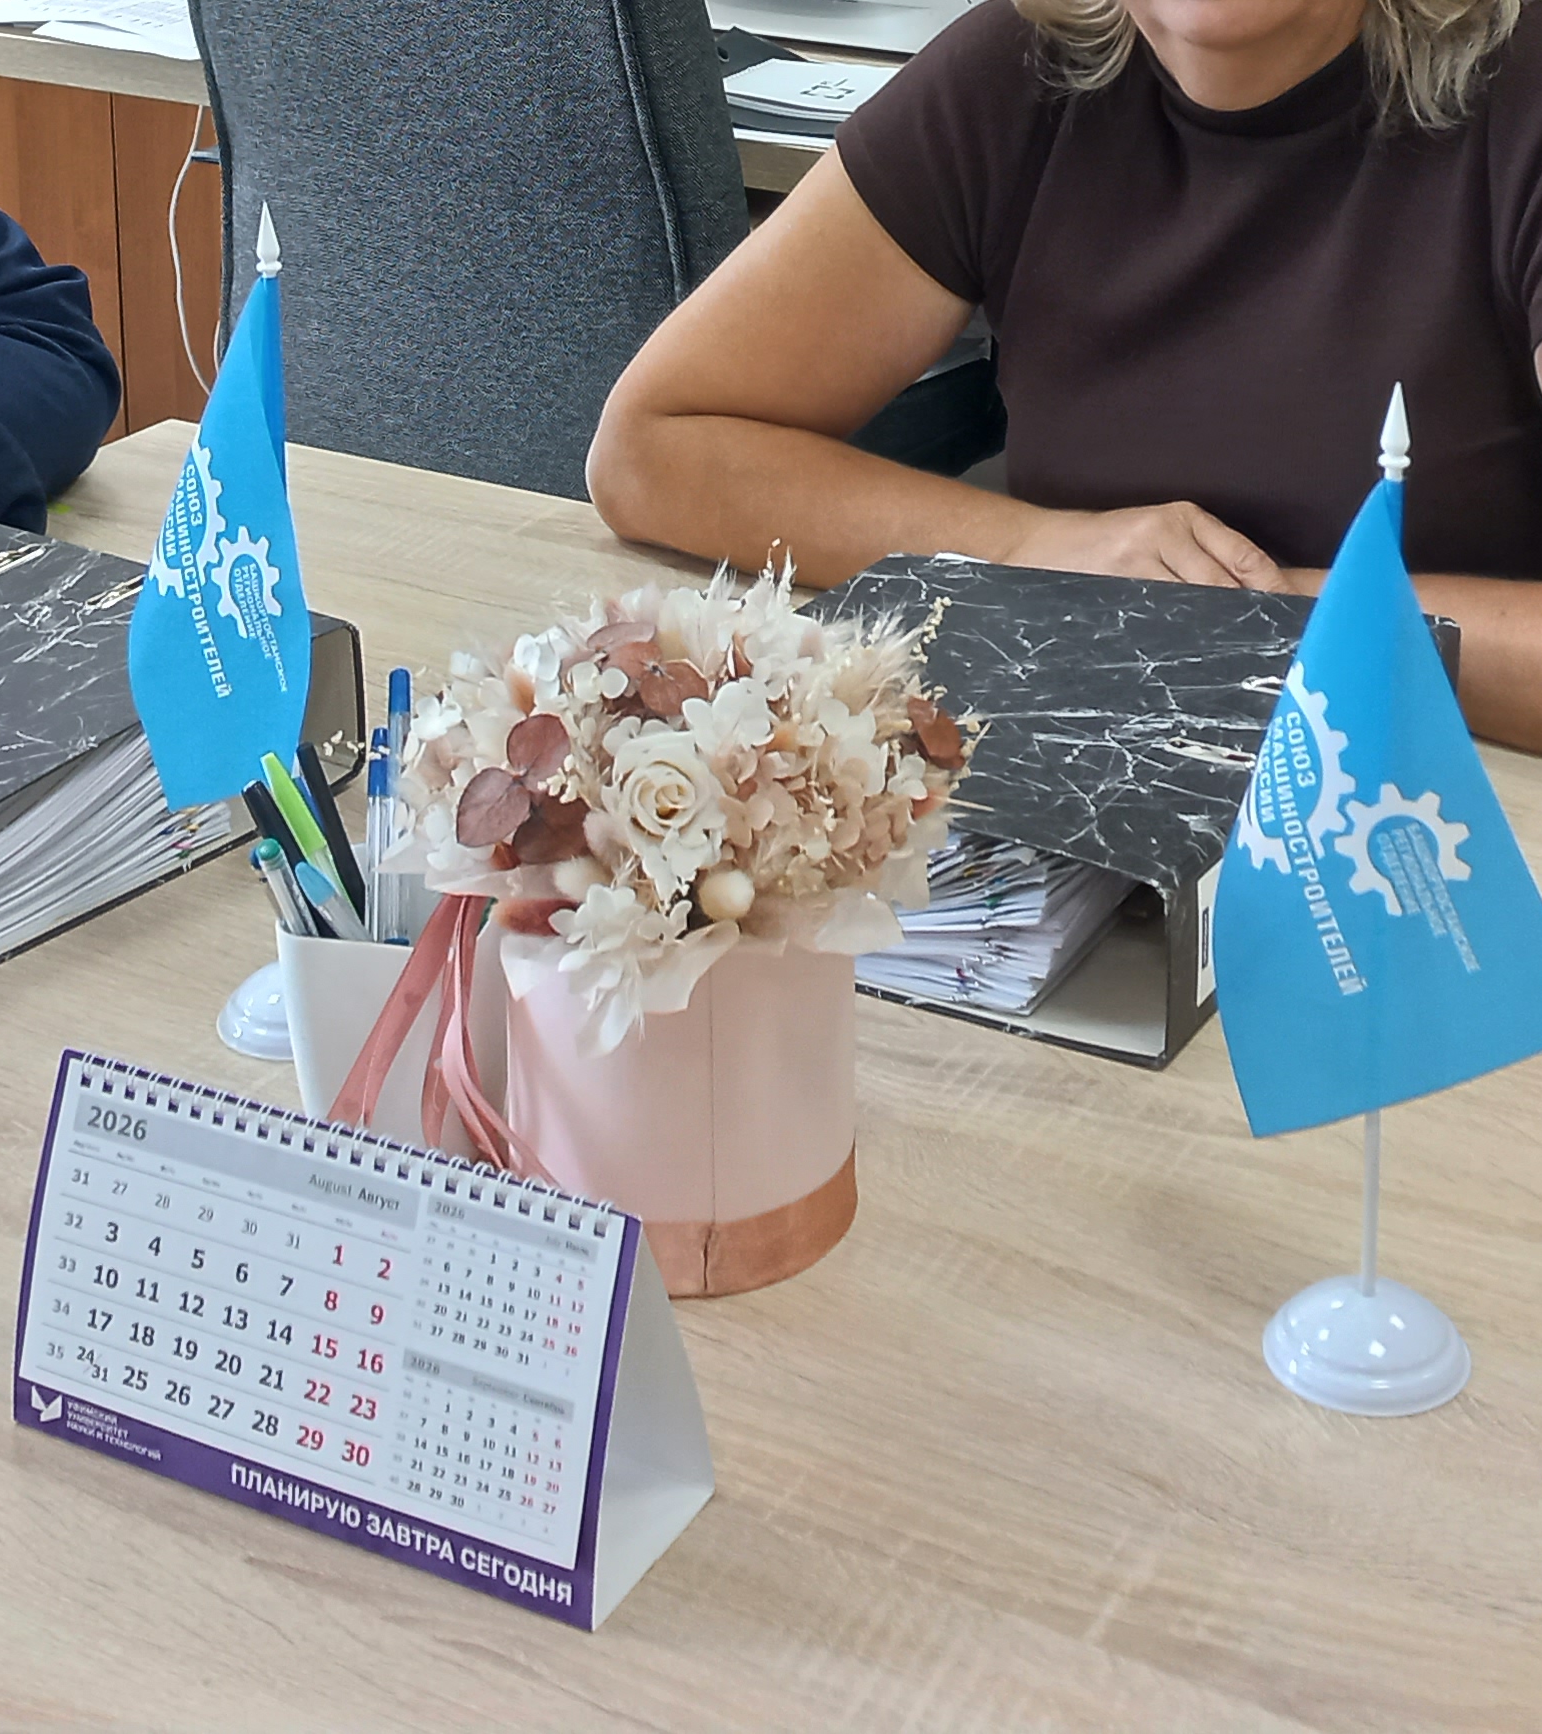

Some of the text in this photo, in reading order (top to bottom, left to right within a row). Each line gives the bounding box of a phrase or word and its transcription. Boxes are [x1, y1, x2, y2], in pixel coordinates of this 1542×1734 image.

[186, 464, 203, 527] СОЮЗ
[1286, 711, 1317, 788] СОЮЗ
[87, 1105, 148, 1141] 2026
[71, 1168, 90, 1186] 31
[112, 1180, 128, 1196] 27
[285, 1232, 301, 1250] 31
[332, 1244, 344, 1266] 1
[377, 1258, 391, 1280] 2
[309, 1173, 400, 1211] August Август
[64, 1212, 384, 1326] 32 3 4 5 6 7 8 9
[93, 1264, 119, 1289] 10
[135, 1278, 160, 1303] 11
[179, 1291, 205, 1317] 12
[222, 1305, 249, 1331] 13
[267, 1319, 293, 1346] 14
[311, 1334, 338, 1359] 15
[357, 1349, 384, 1374] 16
[87, 1308, 113, 1332] 17
[129, 1322, 155, 1347] 18
[172, 1336, 198, 1361] 19
[215, 1349, 242, 1376] 20
[259, 1364, 284, 1391] 21
[304, 1379, 331, 1406] 22
[350, 1394, 377, 1420] 23
[123, 1366, 149, 1391] 25
[165, 1380, 191, 1406] 26
[207, 1394, 235, 1420] 27
[252, 1410, 279, 1437] 28
[296, 1425, 324, 1451] 29
[341, 1440, 370, 1467] 30
[231, 1462, 574, 1607] ПЛАНИРУЮ ЗАВТРА СЕГОДНЯ
